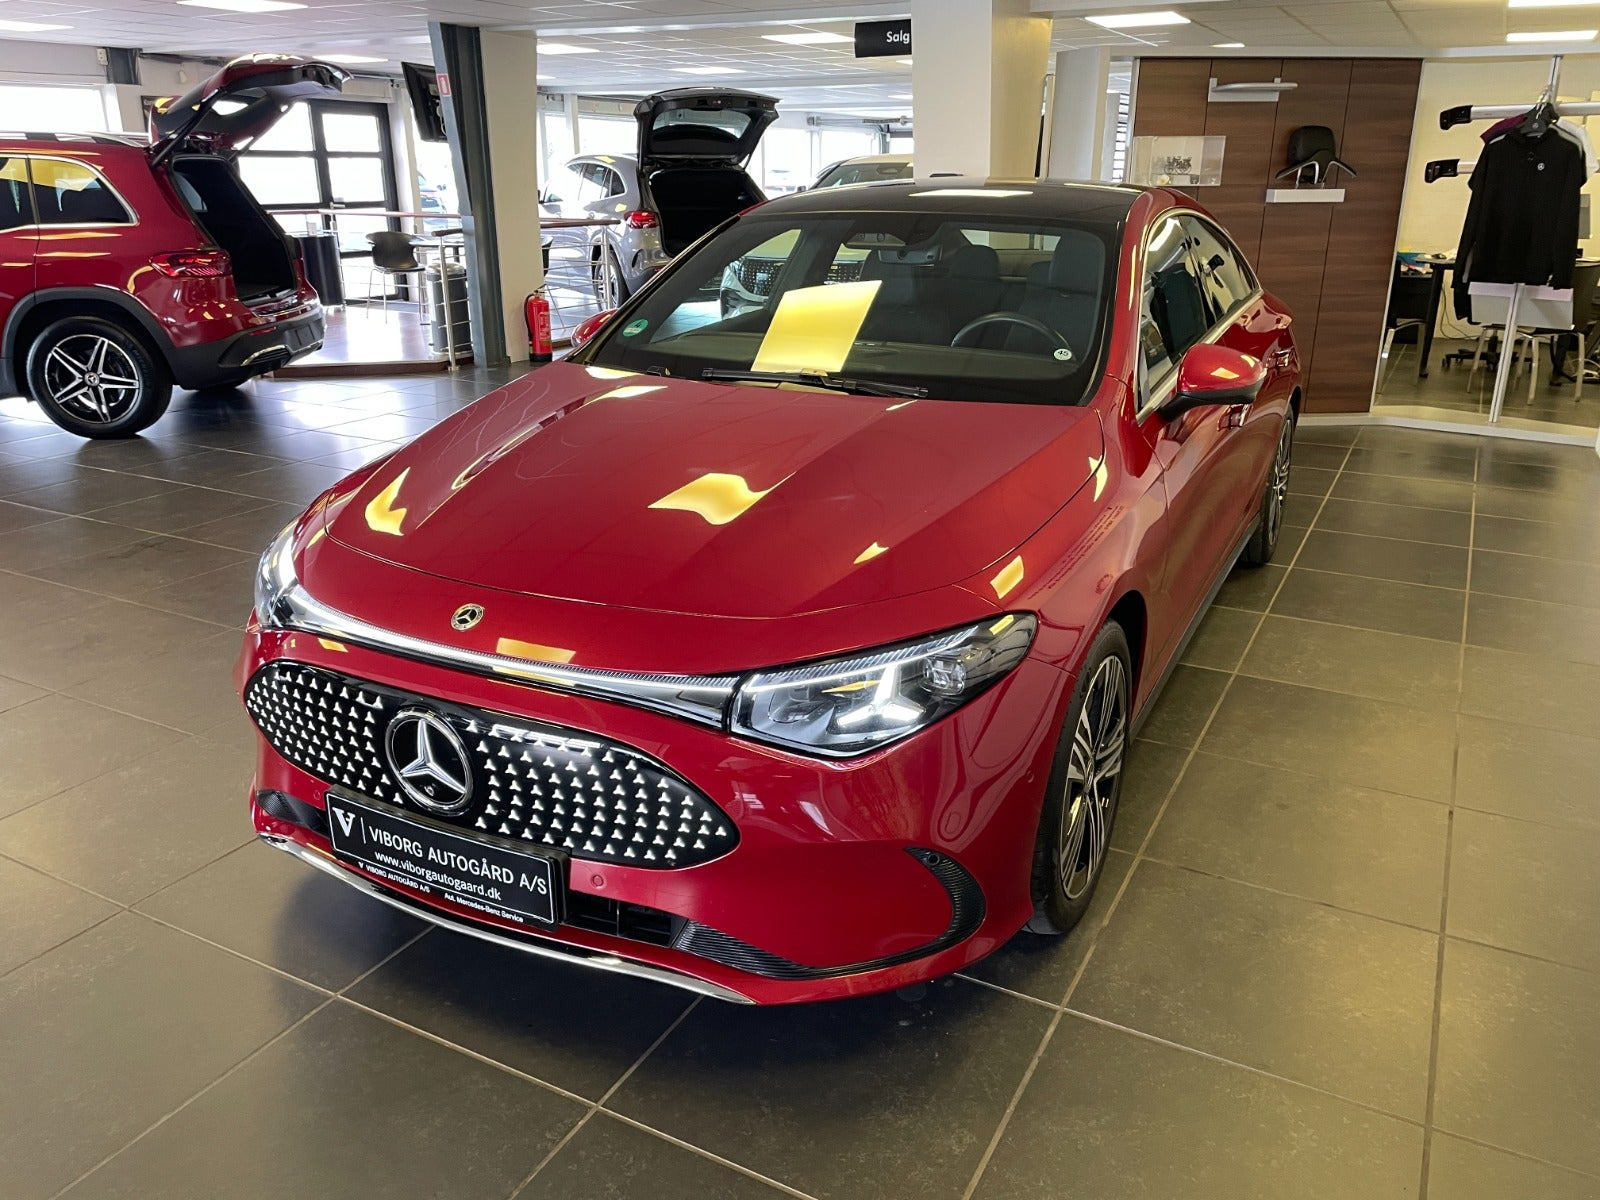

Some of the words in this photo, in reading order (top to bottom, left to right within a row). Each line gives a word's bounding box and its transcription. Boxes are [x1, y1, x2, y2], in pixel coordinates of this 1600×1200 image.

[886, 30, 910, 44] Salg
[365, 864, 388, 878] VIBORG
[369, 826, 423, 857] VIBORG
[428, 847, 514, 884] AUTOGÅRD
[520, 873, 547, 895] A/S
[374, 851, 502, 901] www.viborgautogaard.dk
[456, 896, 501, 917] Mercedes-Benz
[501, 910, 524, 923] Service
